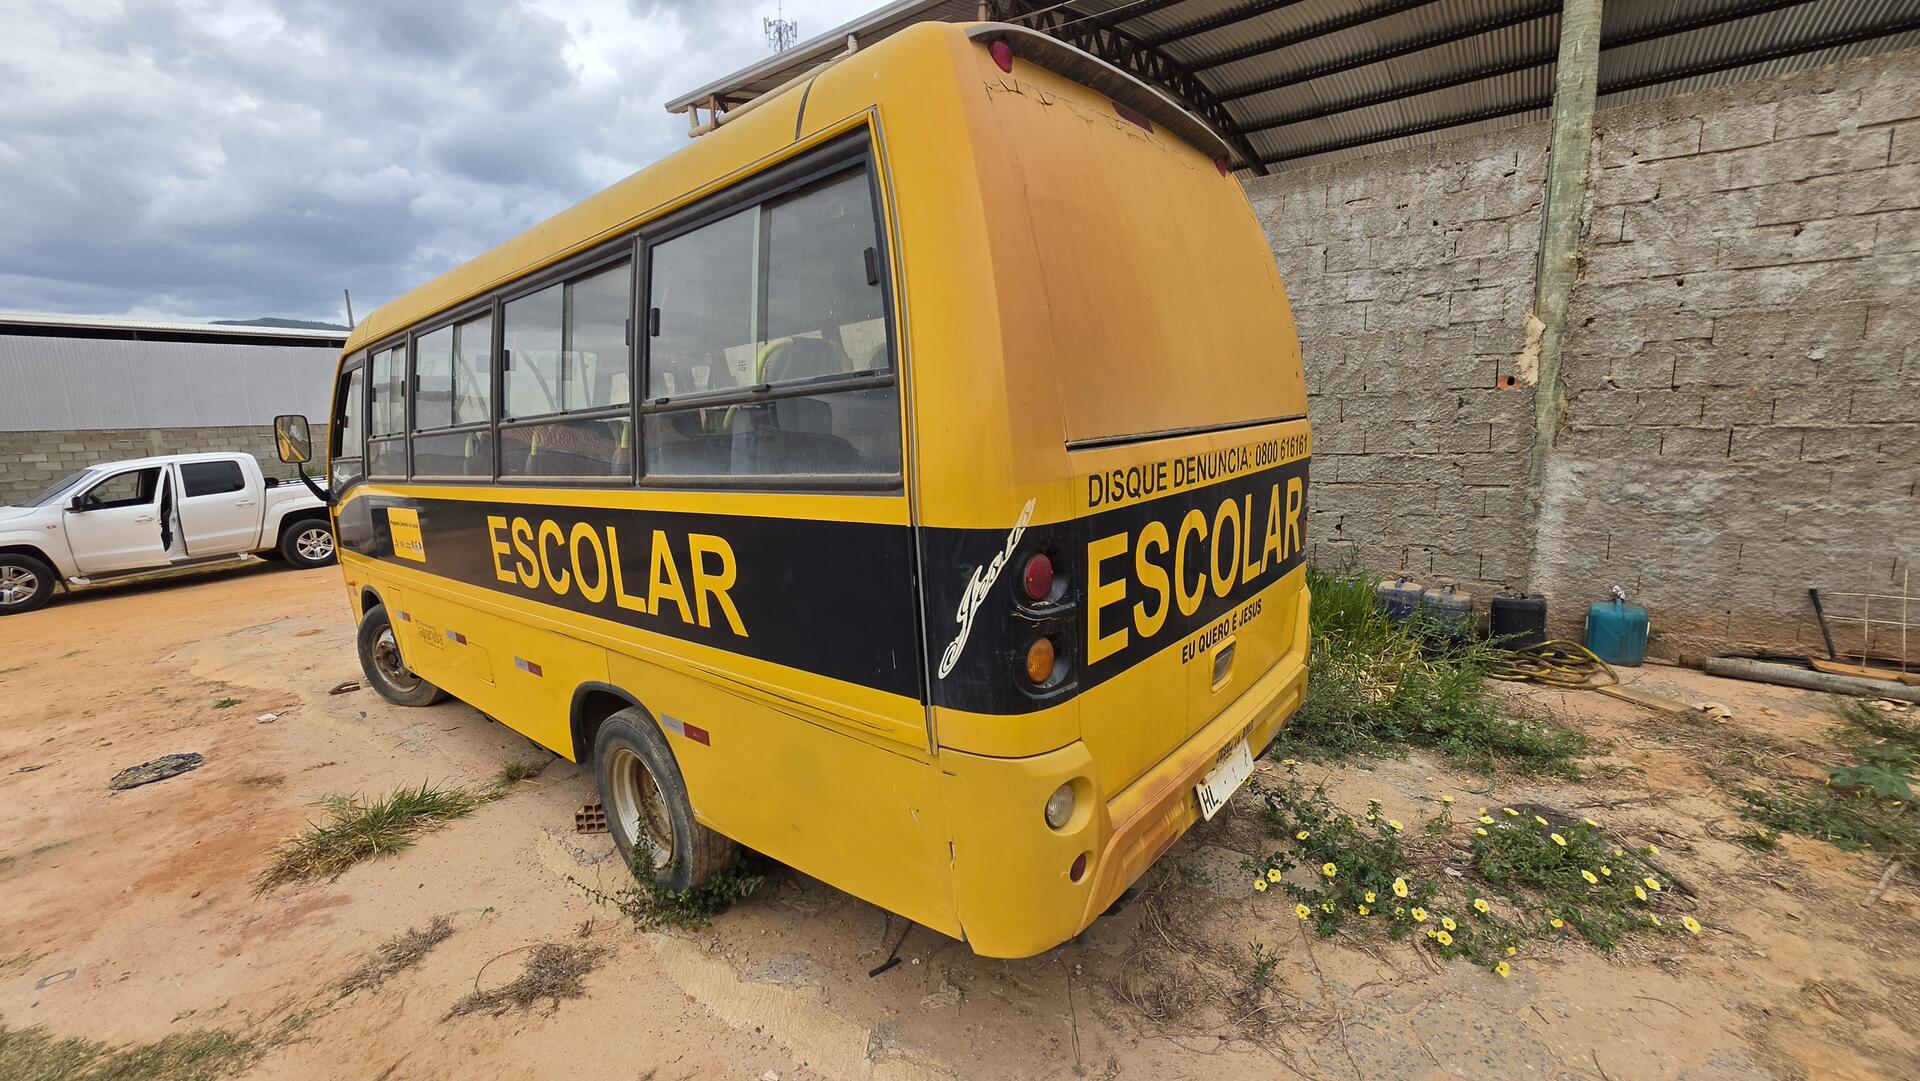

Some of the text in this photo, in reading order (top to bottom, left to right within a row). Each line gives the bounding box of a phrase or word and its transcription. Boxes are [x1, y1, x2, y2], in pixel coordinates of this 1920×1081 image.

[1088, 433, 1308, 507] DISQUE DENUNCIA: 0800 616161
[487, 515, 750, 638] ESCOLAR
[1087, 476, 1303, 666] ESCOLAR
[1182, 640, 1196, 665] EU
[1198, 618, 1230, 654] QUERO
[1238, 598, 1262, 628] JESUS
